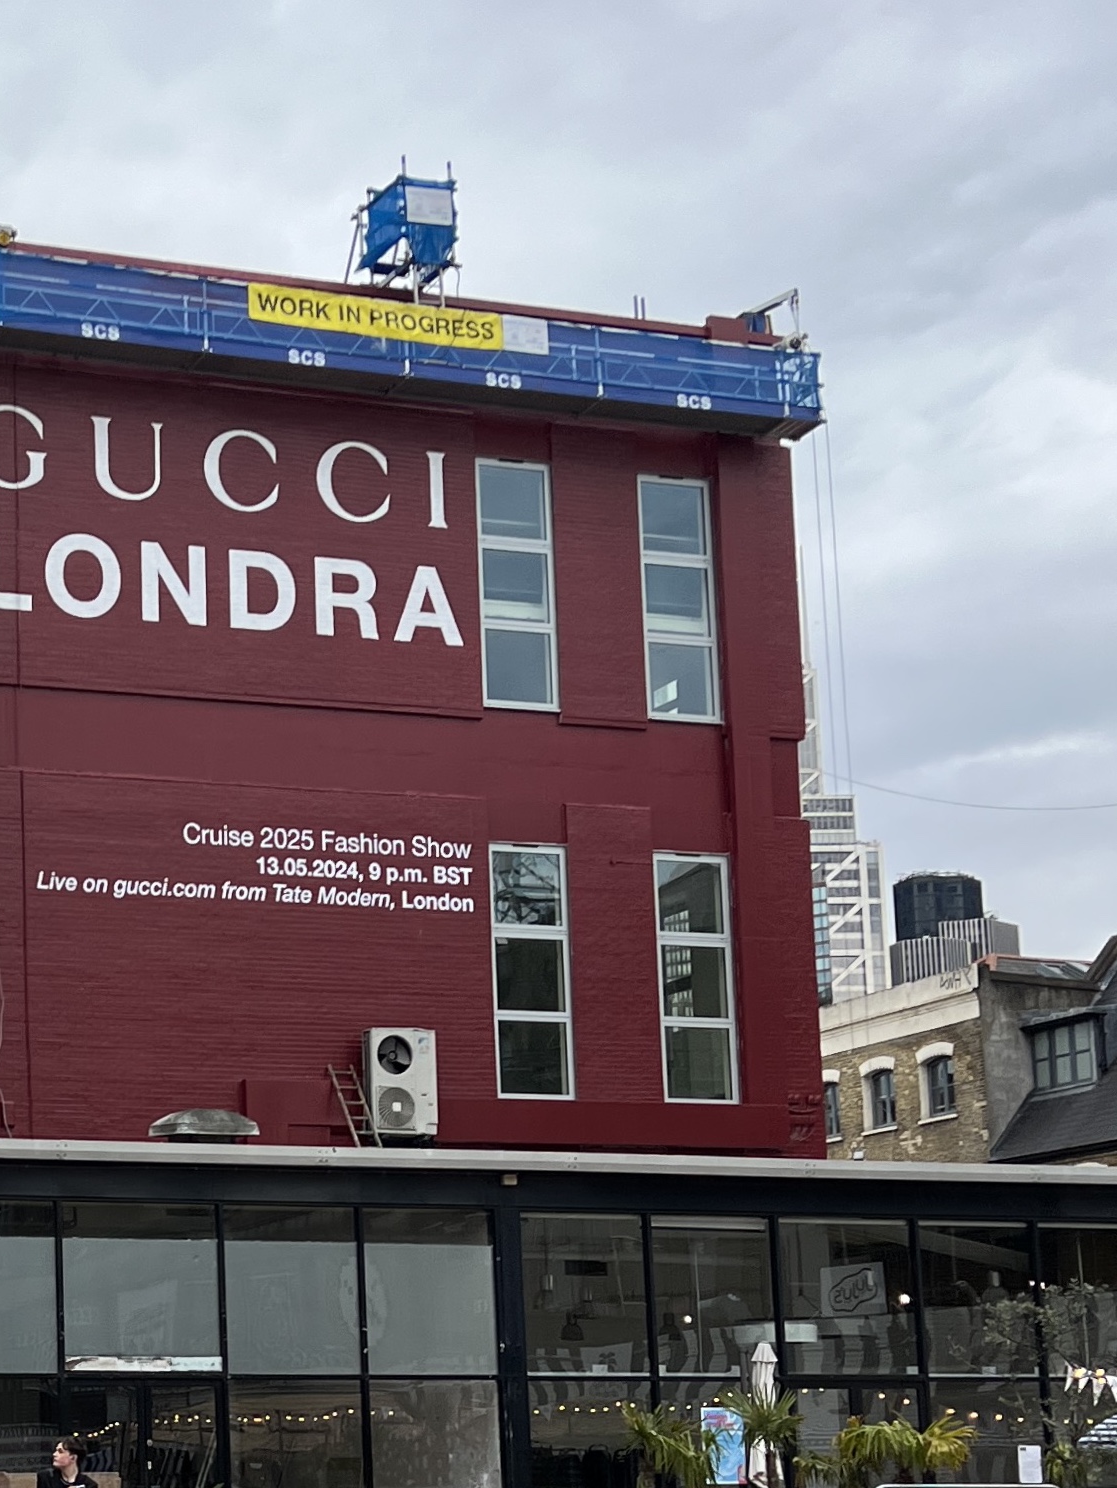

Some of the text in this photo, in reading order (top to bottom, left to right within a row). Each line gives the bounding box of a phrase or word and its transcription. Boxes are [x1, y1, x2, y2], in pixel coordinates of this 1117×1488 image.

[257, 292, 331, 322] WORK
[338, 303, 362, 325] IN
[369, 308, 495, 341] PROGRESS
[81, 322, 120, 341] SCS
[288, 348, 326, 367] SCS
[485, 371, 522, 390] SCS
[676, 393, 712, 410] SCS
[182, 821, 473, 861] Cruise 2025 Fashion Show
[255, 855, 473, 886] 13.05.2024, 9 p.m. BST
[36, 870, 475, 914] Live on gucci.com from Tate Modern, London
